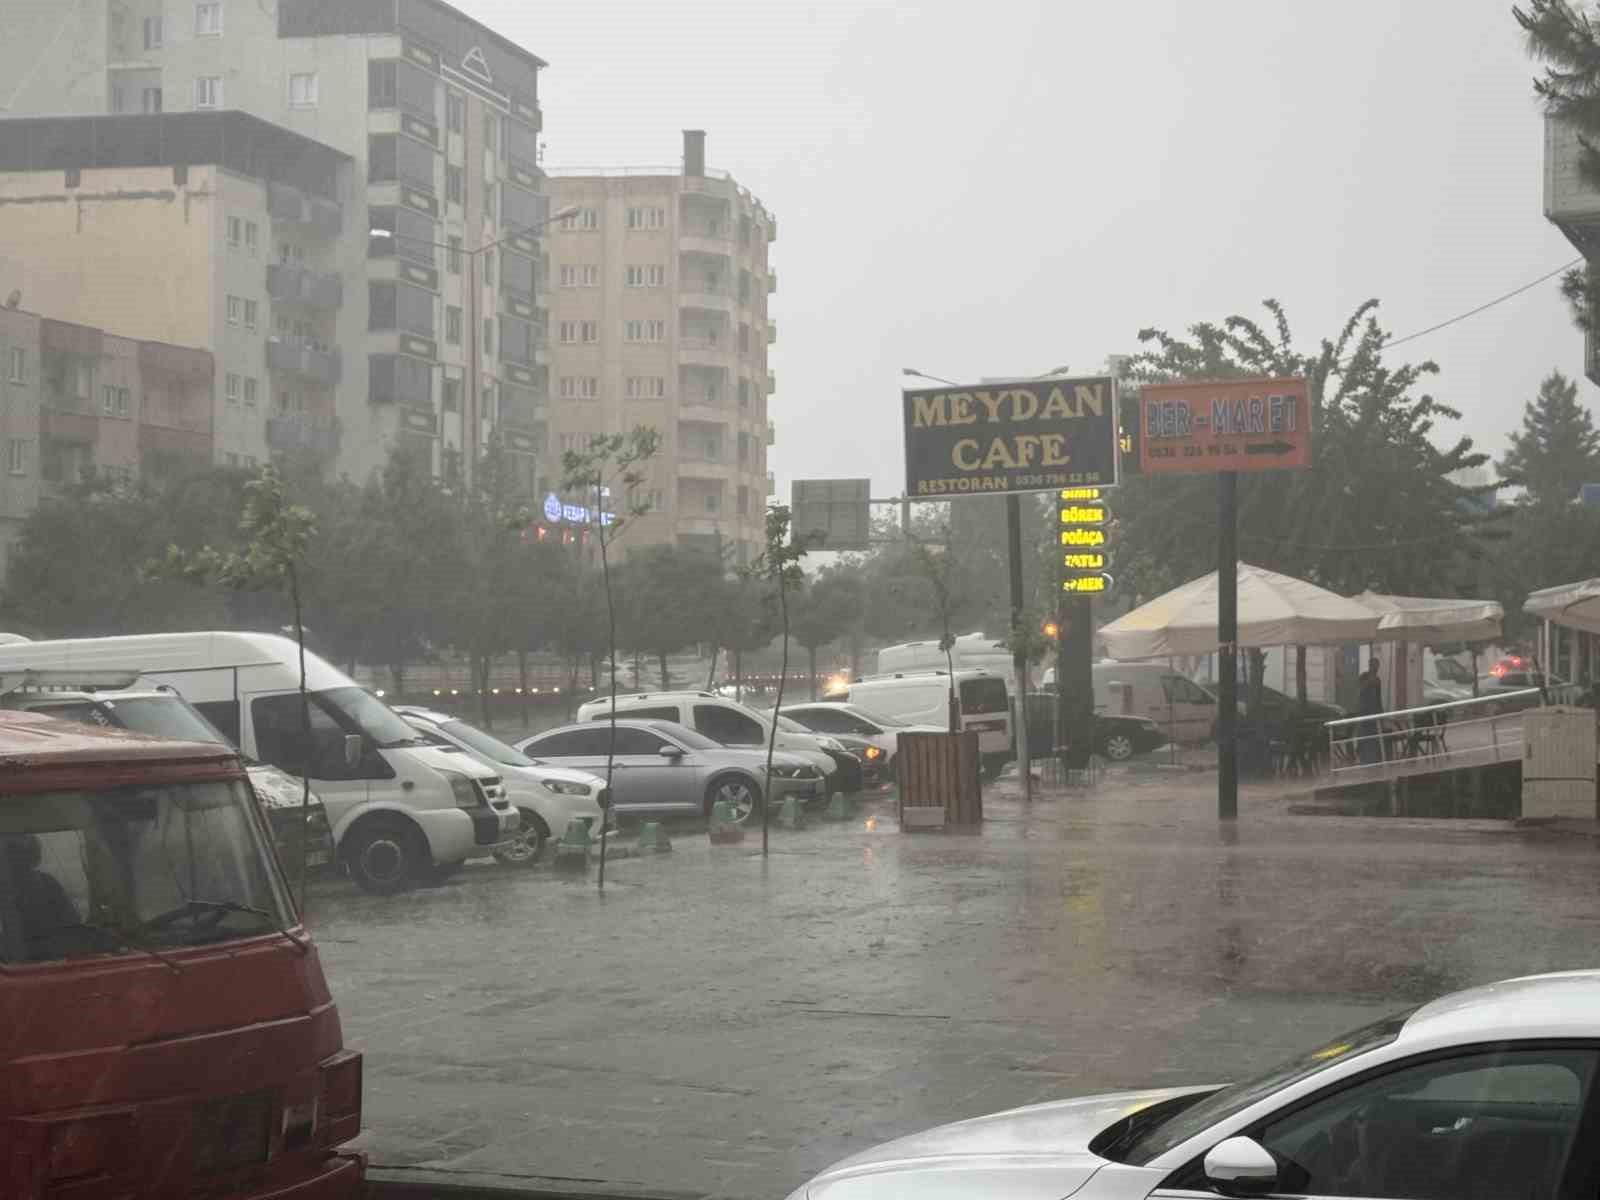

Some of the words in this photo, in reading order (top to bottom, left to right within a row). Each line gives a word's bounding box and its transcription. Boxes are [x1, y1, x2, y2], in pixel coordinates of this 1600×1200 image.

[911, 383, 1104, 428] MEYDAN
[951, 434, 1071, 471] CAFE
[917, 475, 1009, 494] RESTORAN
[1060, 506, 1104, 523] BÖREK
[1060, 528, 1105, 546] POĞAÇA
